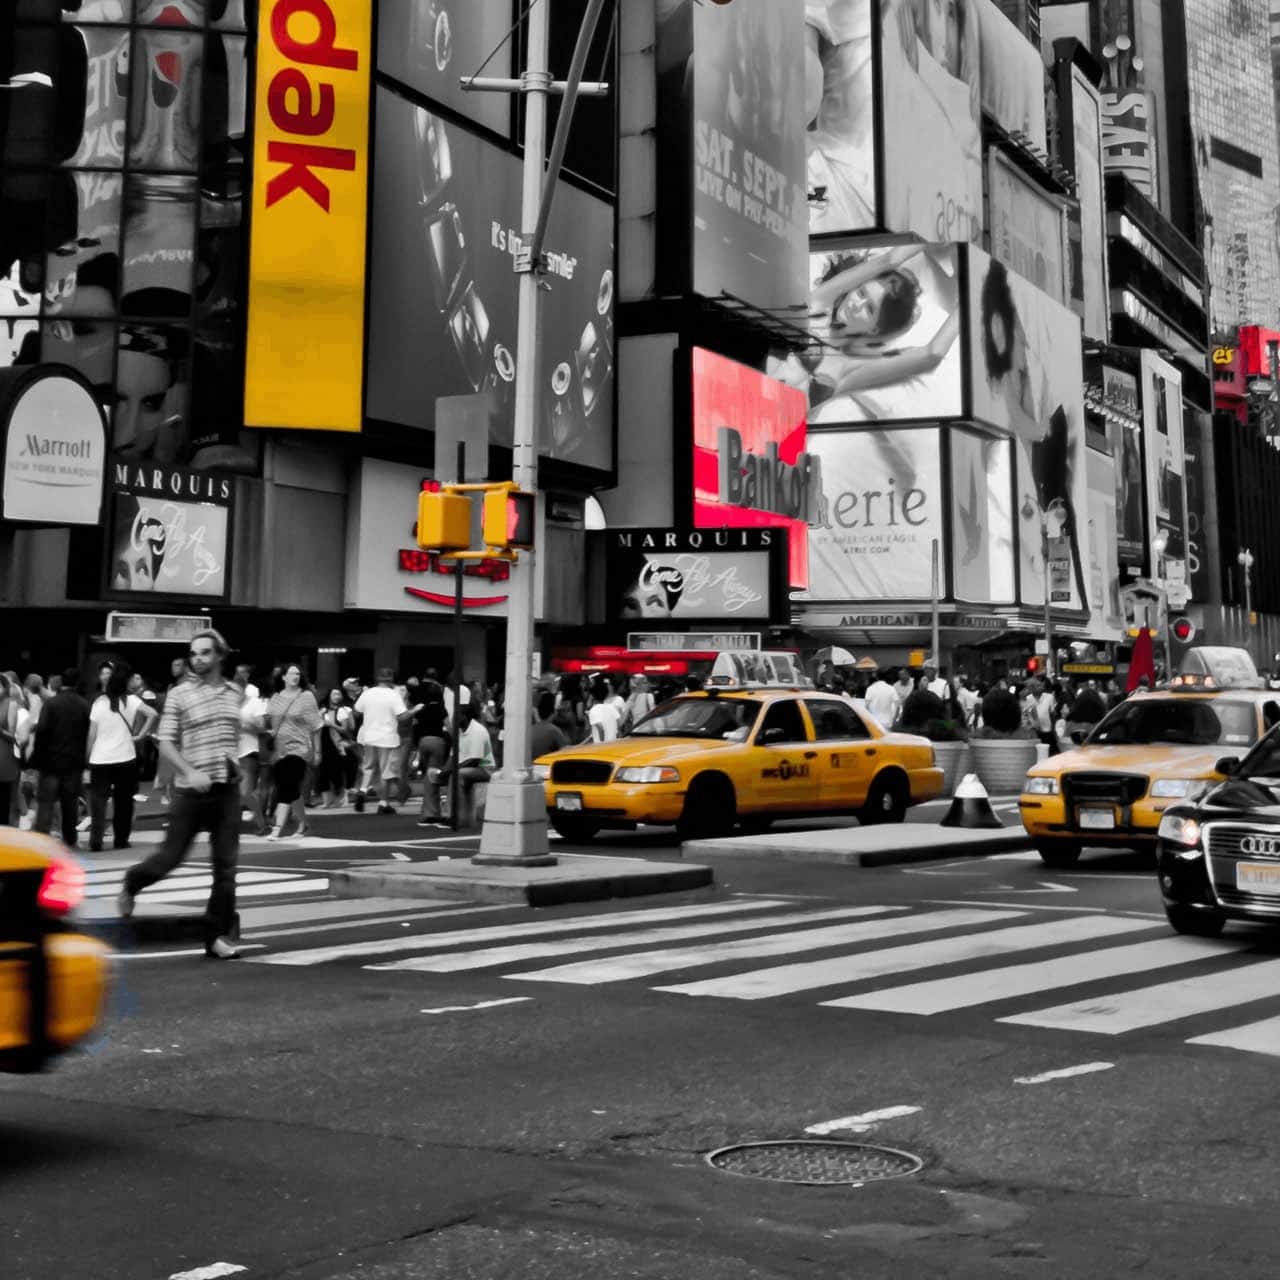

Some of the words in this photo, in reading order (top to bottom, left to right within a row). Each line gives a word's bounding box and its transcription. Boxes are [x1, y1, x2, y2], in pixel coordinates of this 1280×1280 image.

[695, 119, 737, 184] SAT.
[743, 148, 790, 218] SEPT.
[695, 165, 723, 202] LIVE
[18, 432, 92, 458] Marriott
[114, 463, 230, 499] MARQUIS
[618, 530, 772, 548] MARQUIS
[639, 558, 684, 593] Come
[840, 615, 914, 627] AMERICAN
